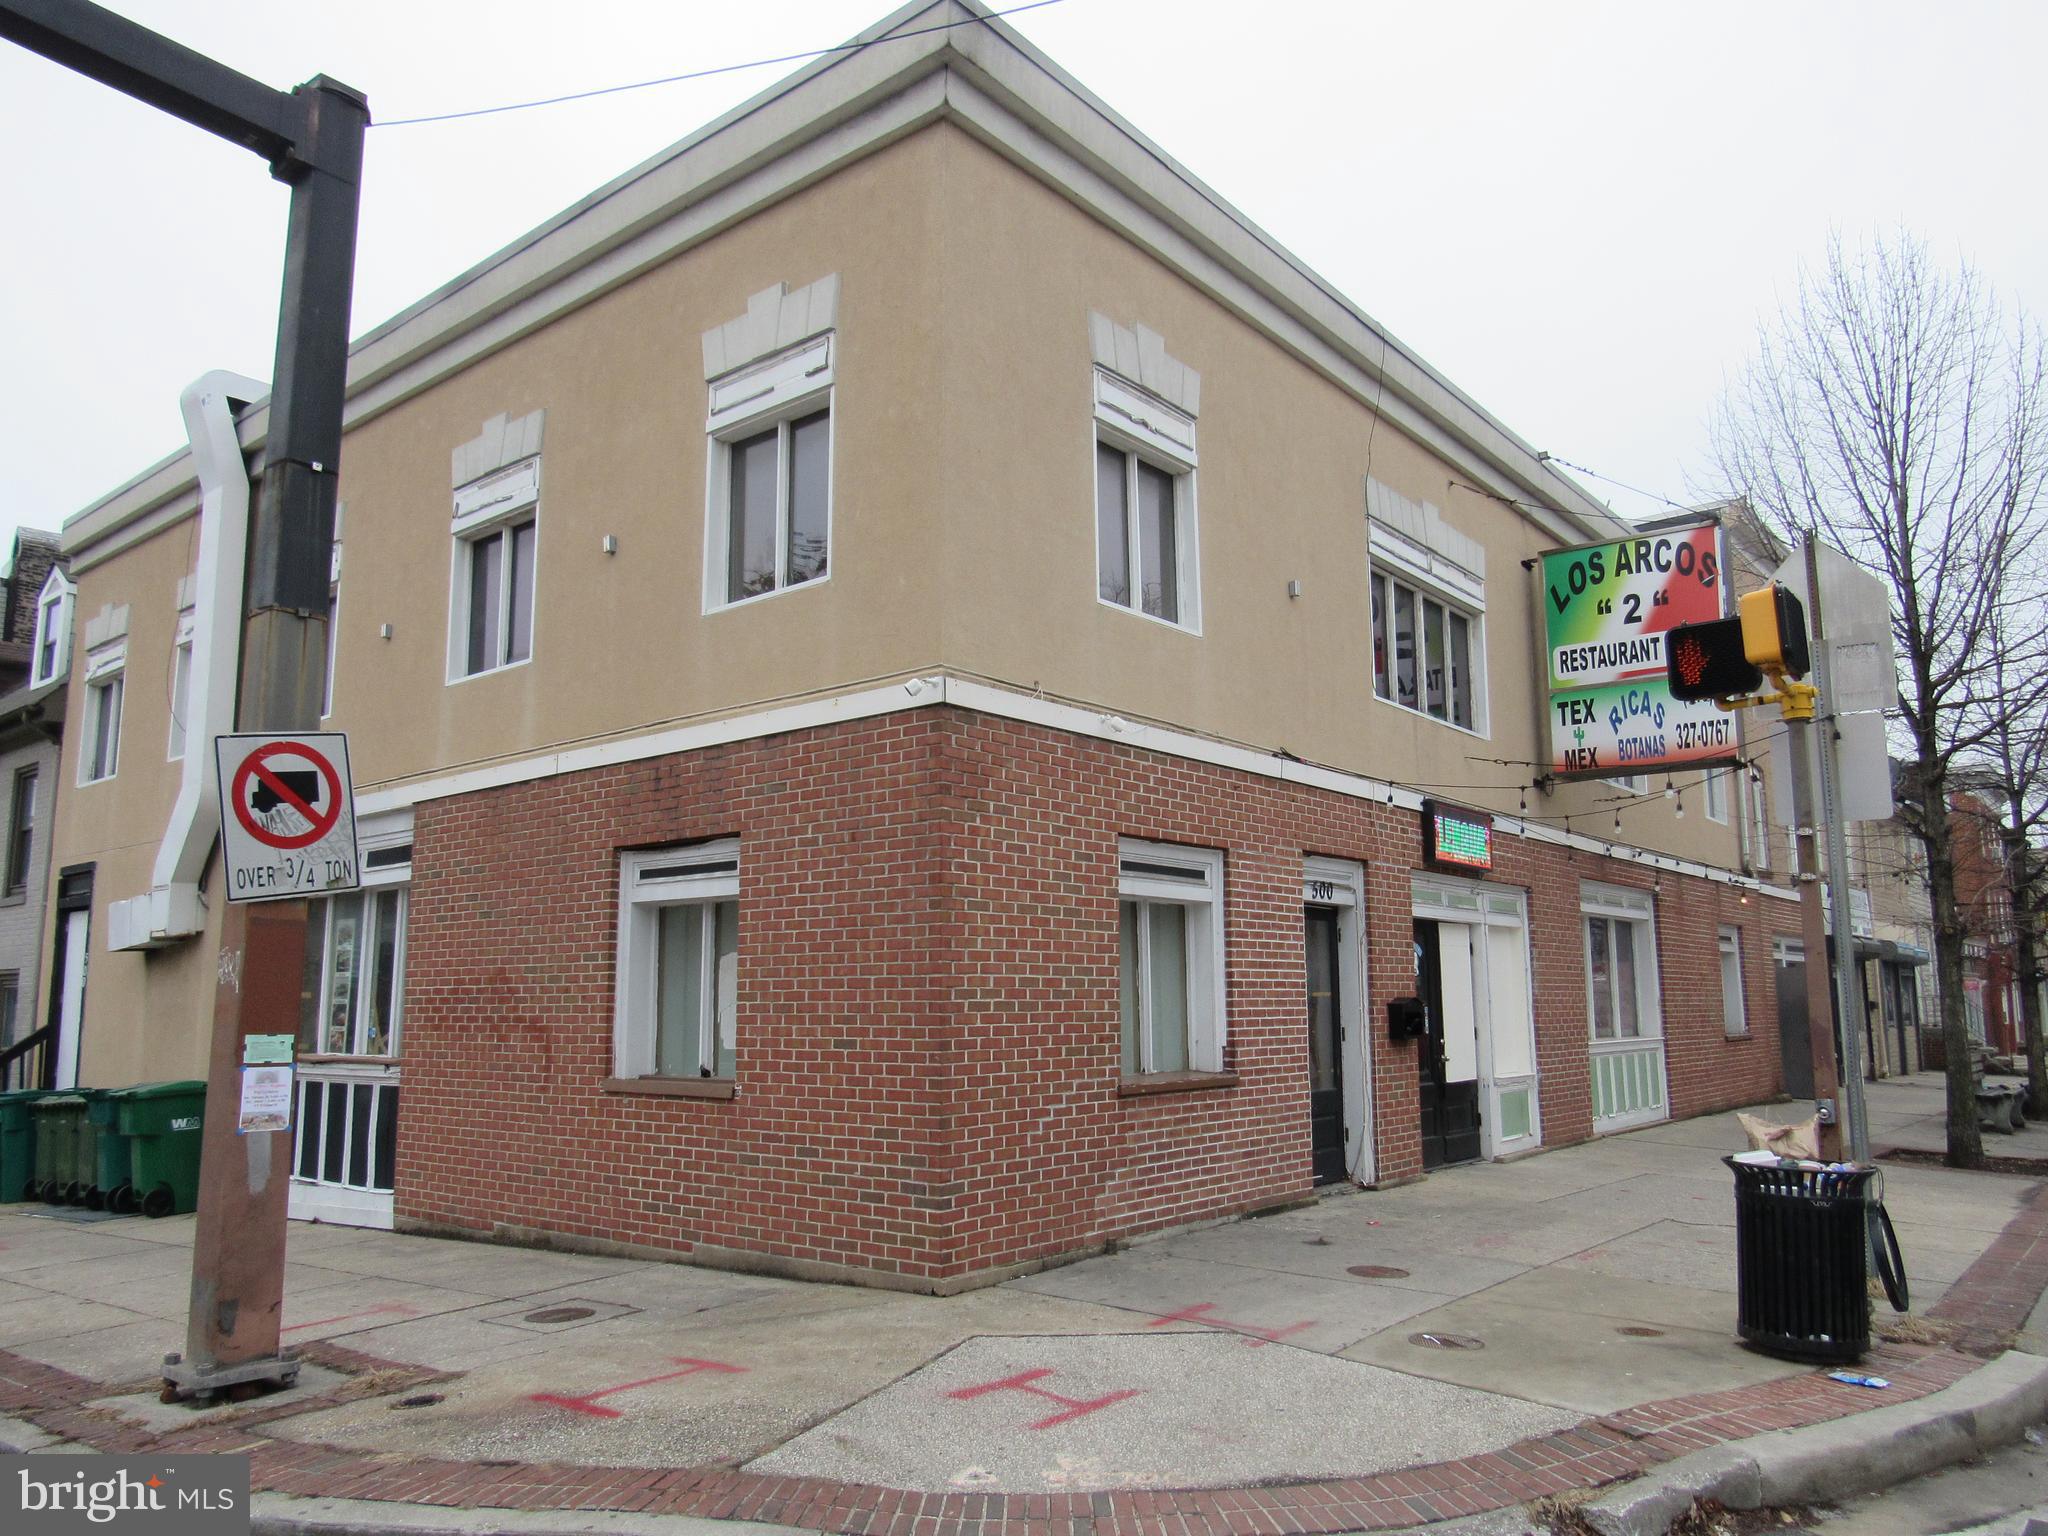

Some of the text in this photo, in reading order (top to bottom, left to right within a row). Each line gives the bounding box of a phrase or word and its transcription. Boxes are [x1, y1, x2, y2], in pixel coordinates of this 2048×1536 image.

[1550, 538, 1717, 614] LOS ARCOS
[1559, 637, 1660, 673] RESTAURANT
[1557, 698, 1596, 726] TEX
[1608, 690, 1665, 735] RICAS
[1618, 734, 1666, 760] BOTANAS
[1676, 719, 1729, 750] 327-0767
[1564, 747, 1599, 771] MEX
[236, 858, 351, 889] OVER 3/4 TON
[1312, 880, 1333, 900] 500
